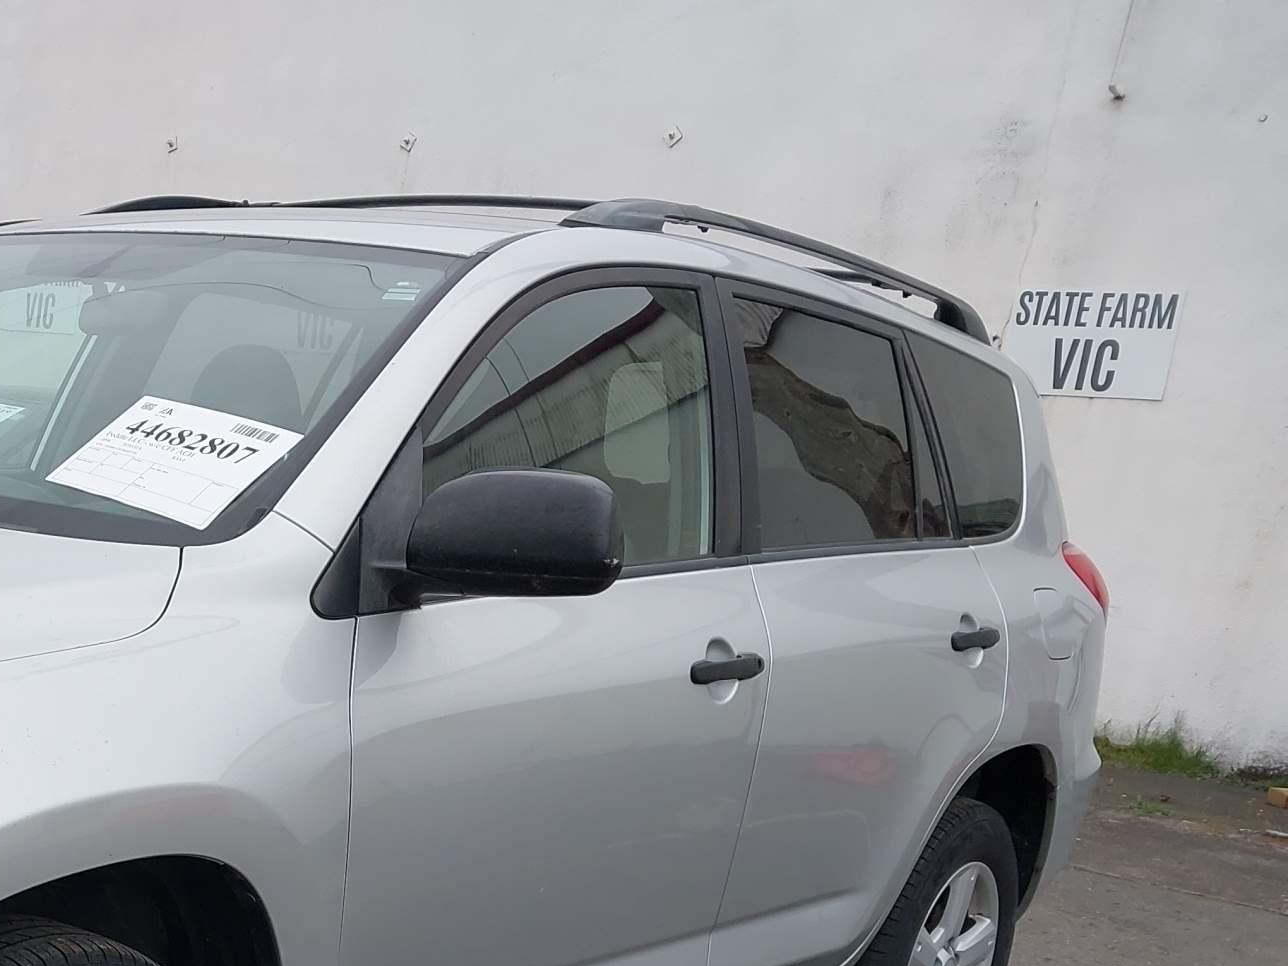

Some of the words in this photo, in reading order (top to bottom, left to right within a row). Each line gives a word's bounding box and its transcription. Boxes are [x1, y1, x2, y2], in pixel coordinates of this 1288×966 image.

[25, 292, 57, 330] VIC
[1015, 290, 1094, 328] STATE
[1096, 292, 1180, 330] FARM
[1052, 337, 1120, 392] VIC
[124, 419, 260, 464] 44682807
